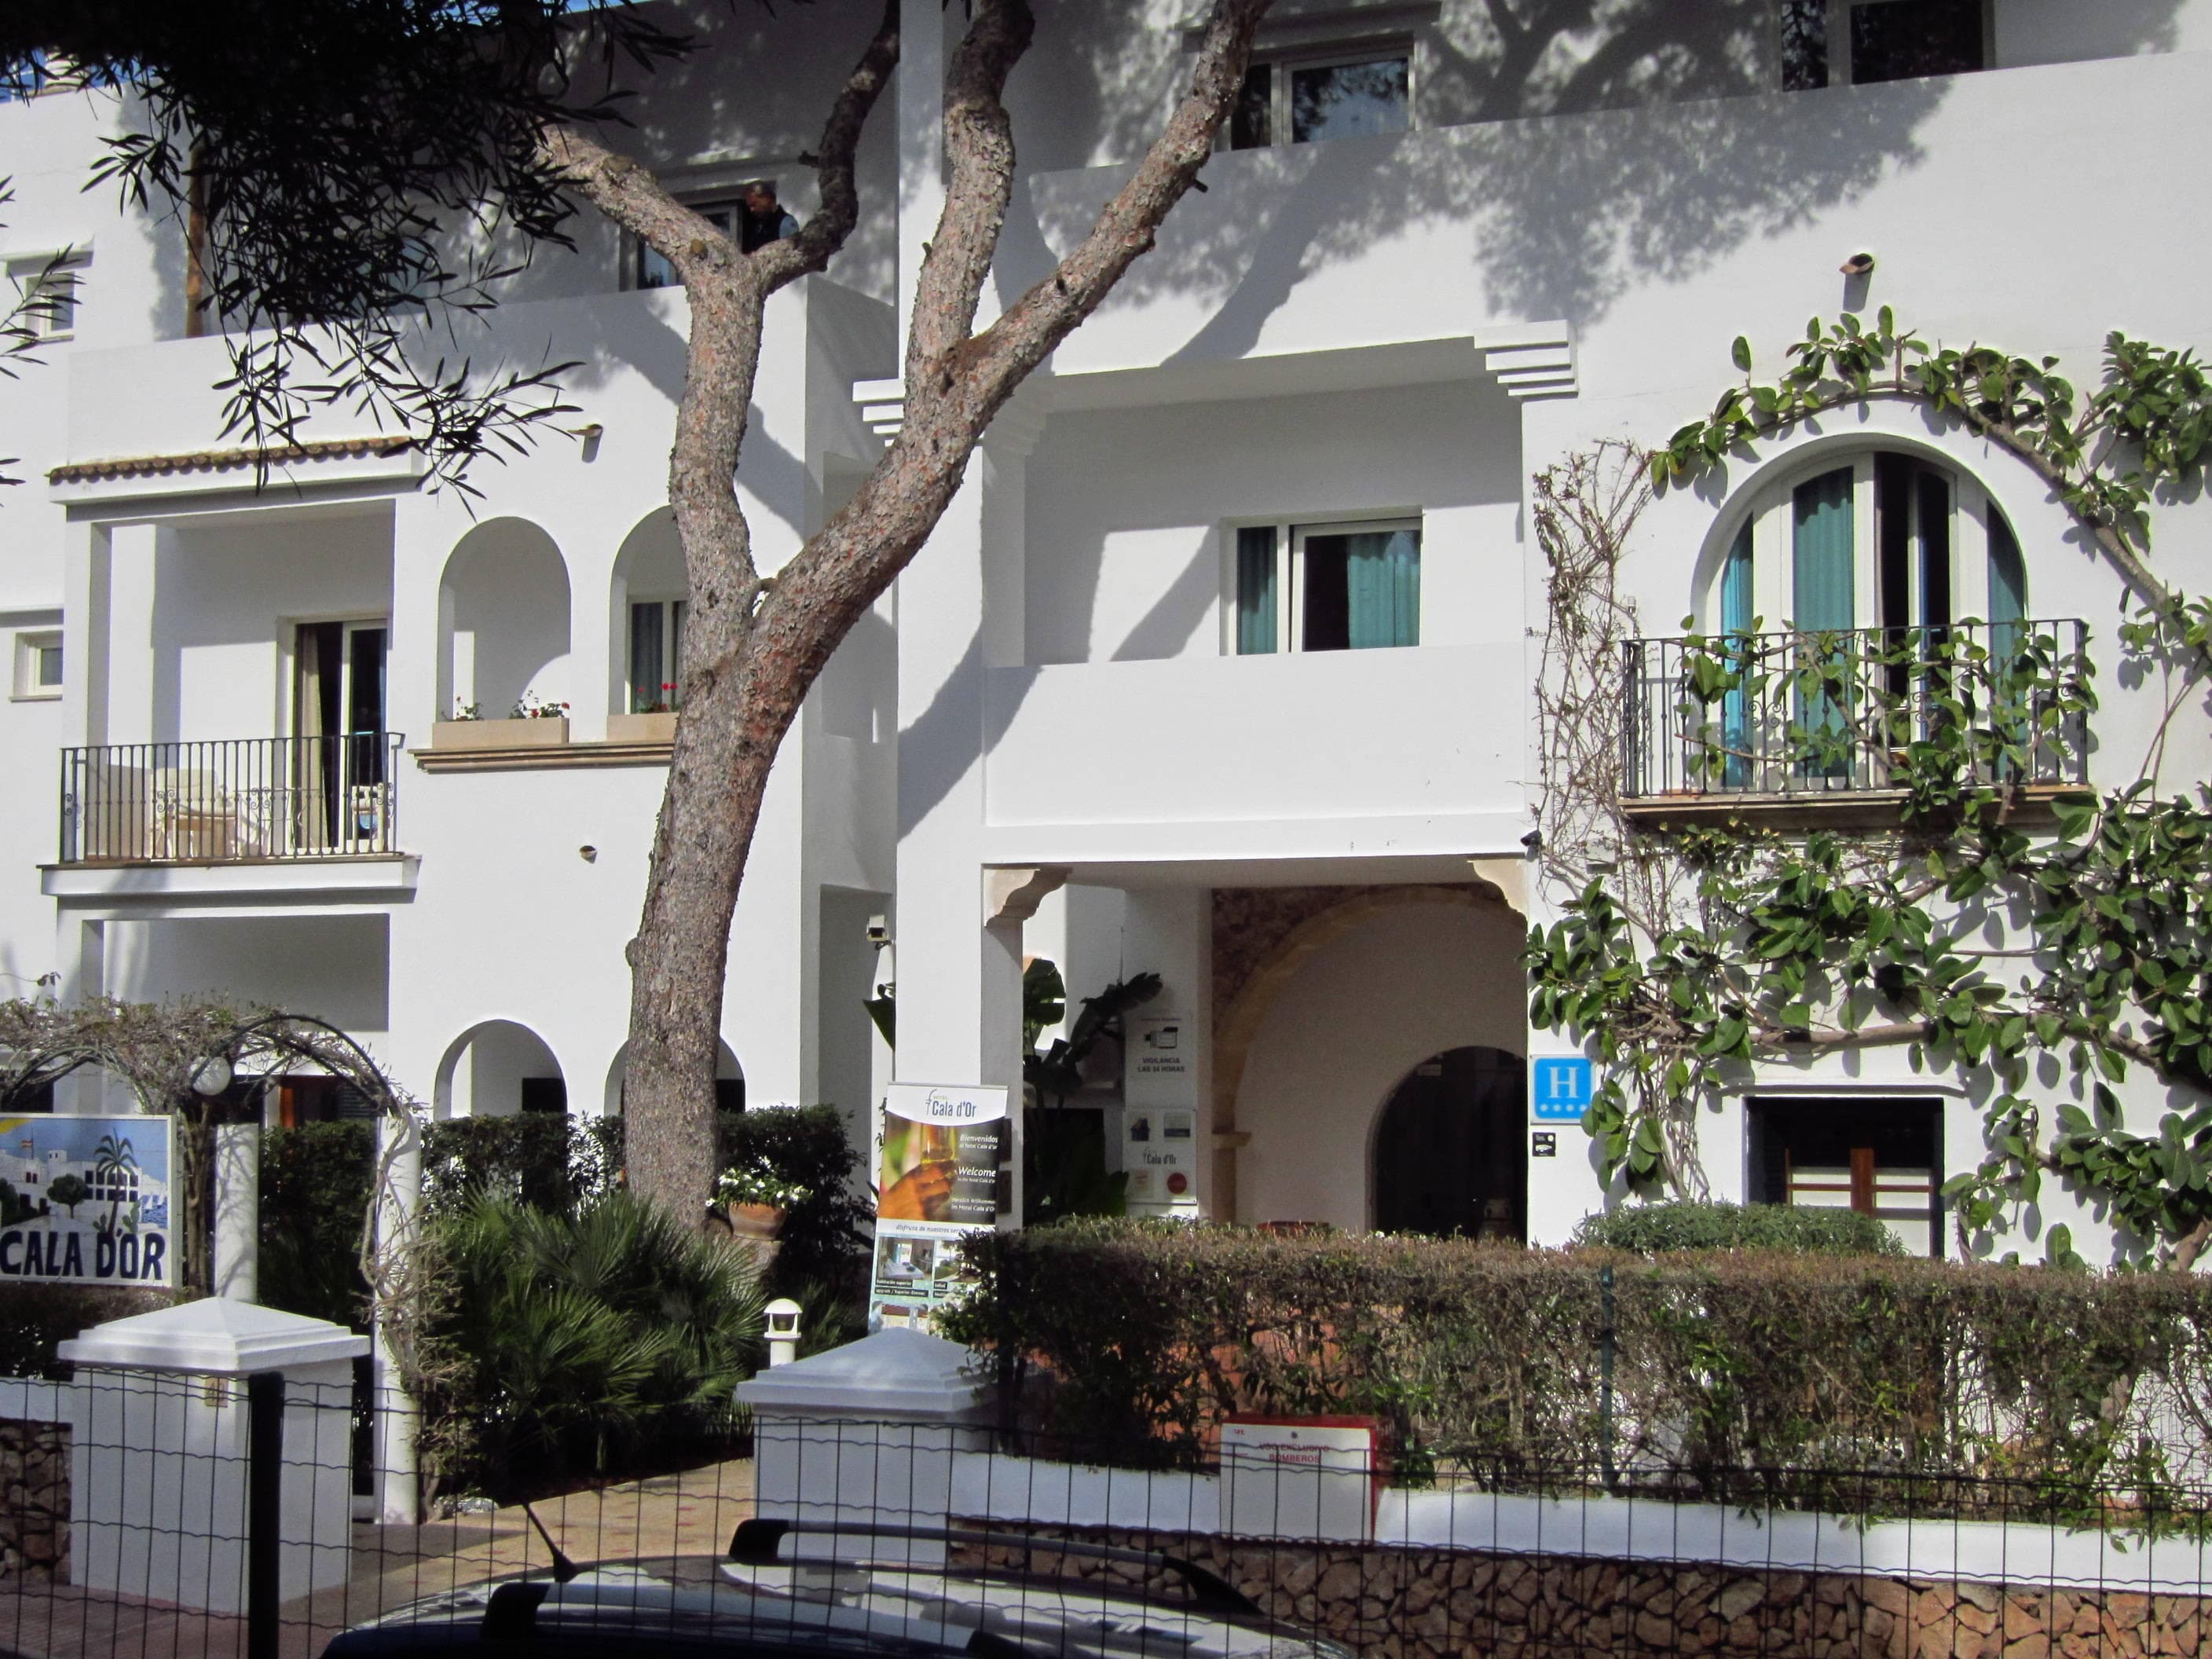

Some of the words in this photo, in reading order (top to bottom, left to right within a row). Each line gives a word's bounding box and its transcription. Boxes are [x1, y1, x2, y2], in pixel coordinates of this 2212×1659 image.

[1547, 1067, 1580, 1098] H
[932, 1101, 953, 1116] Cala
[957, 1101, 977, 1118] d'Or
[960, 1134, 998, 1143] Bienvenidos
[1147, 1153, 1161, 1164] Cala
[958, 1166, 996, 1177] Welcome
[0, 1230, 84, 1276] CALA
[96, 1228, 166, 1280] D'OR
[1269, 1453, 1320, 1463] BOMBEROS
